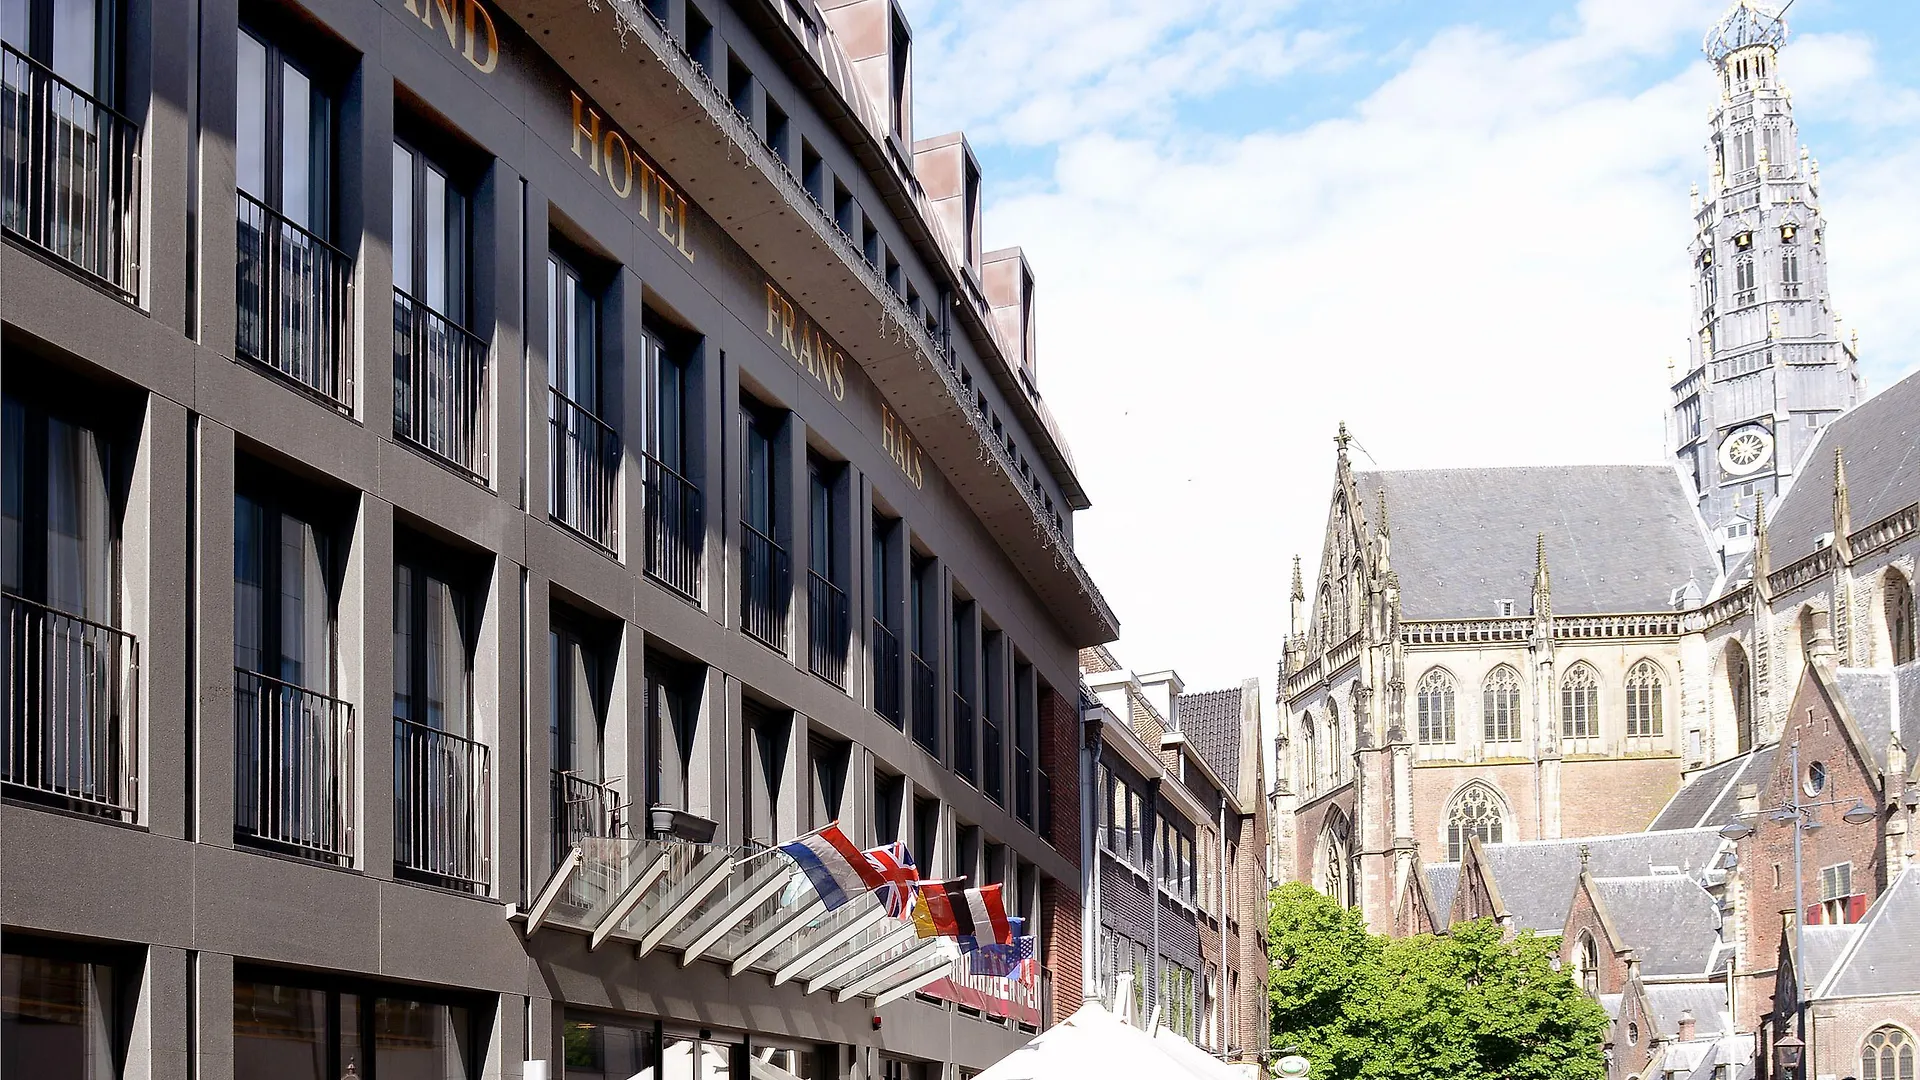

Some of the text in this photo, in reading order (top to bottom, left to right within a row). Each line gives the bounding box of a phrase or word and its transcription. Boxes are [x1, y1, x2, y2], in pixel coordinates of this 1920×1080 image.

[403, 0, 923, 490] ND HOTEL FRANS HALS
